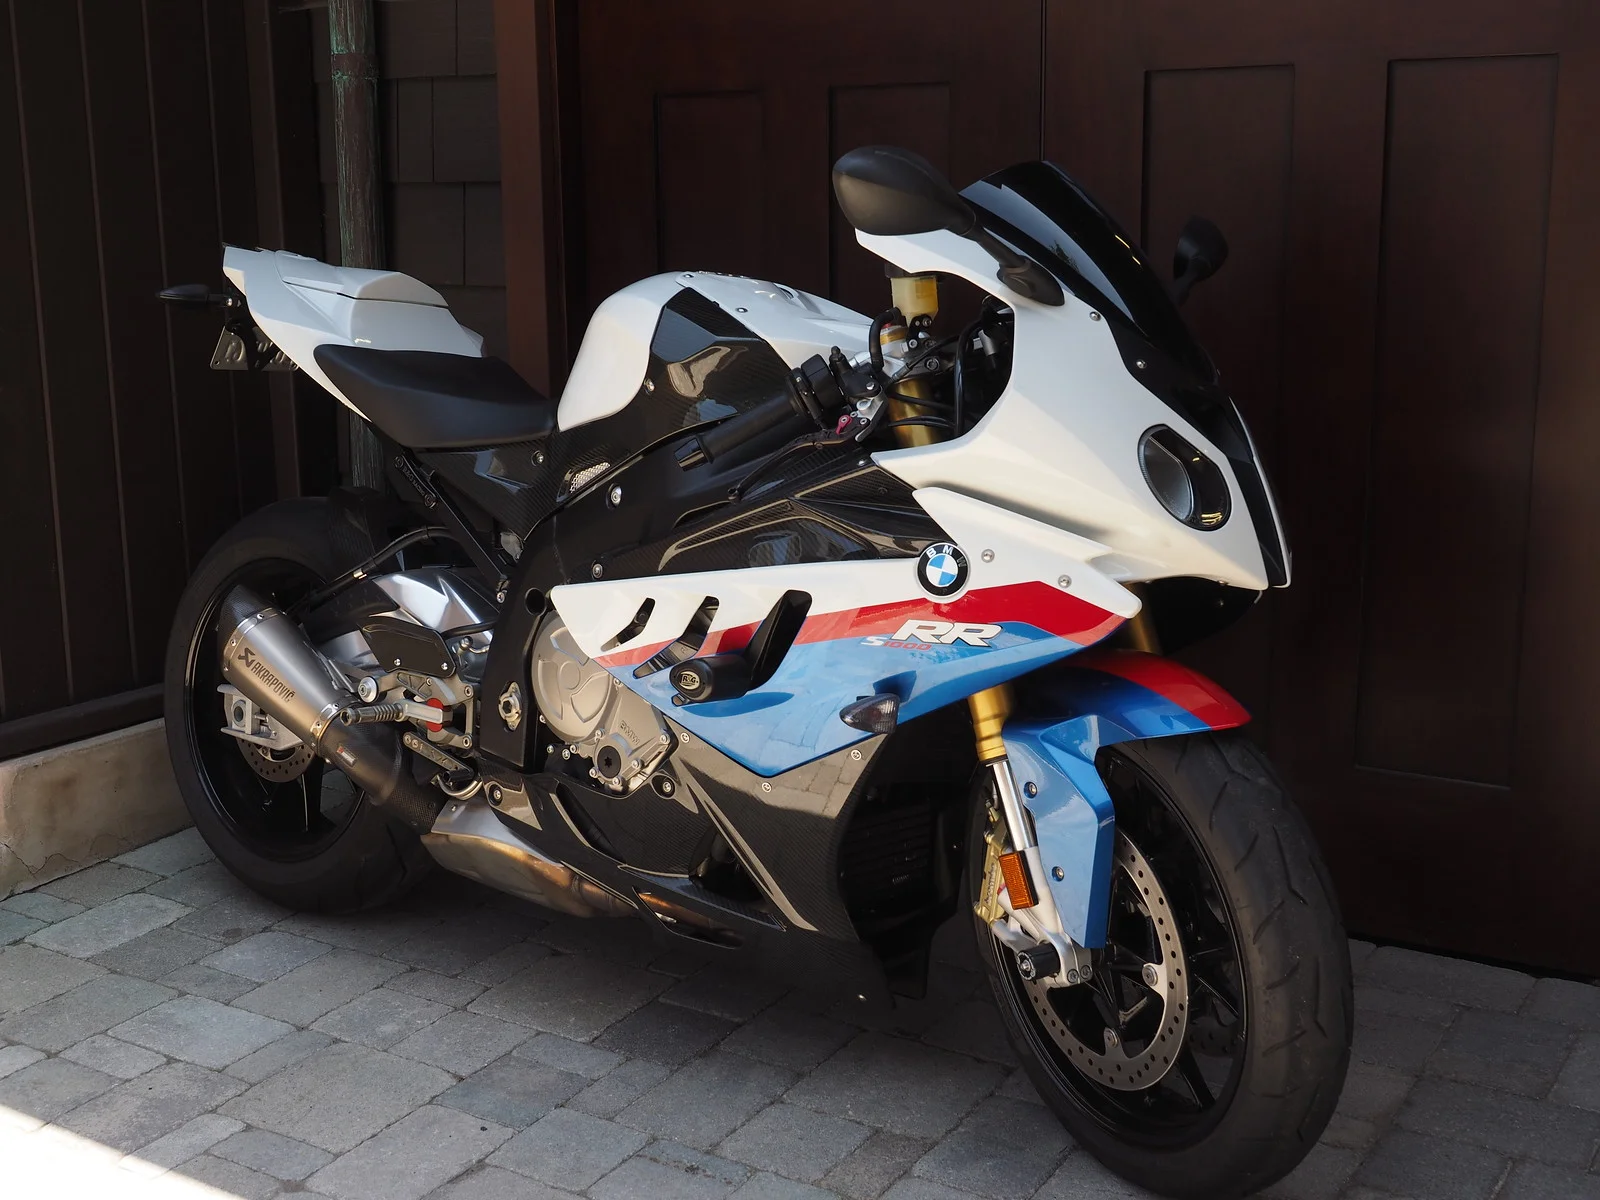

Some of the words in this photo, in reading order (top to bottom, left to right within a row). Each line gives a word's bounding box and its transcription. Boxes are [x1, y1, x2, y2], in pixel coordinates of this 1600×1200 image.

[926, 544, 967, 568] BMW
[860, 636, 932, 651] S1000
[891, 619, 1003, 647] RR
[619, 719, 641, 746] BMW
